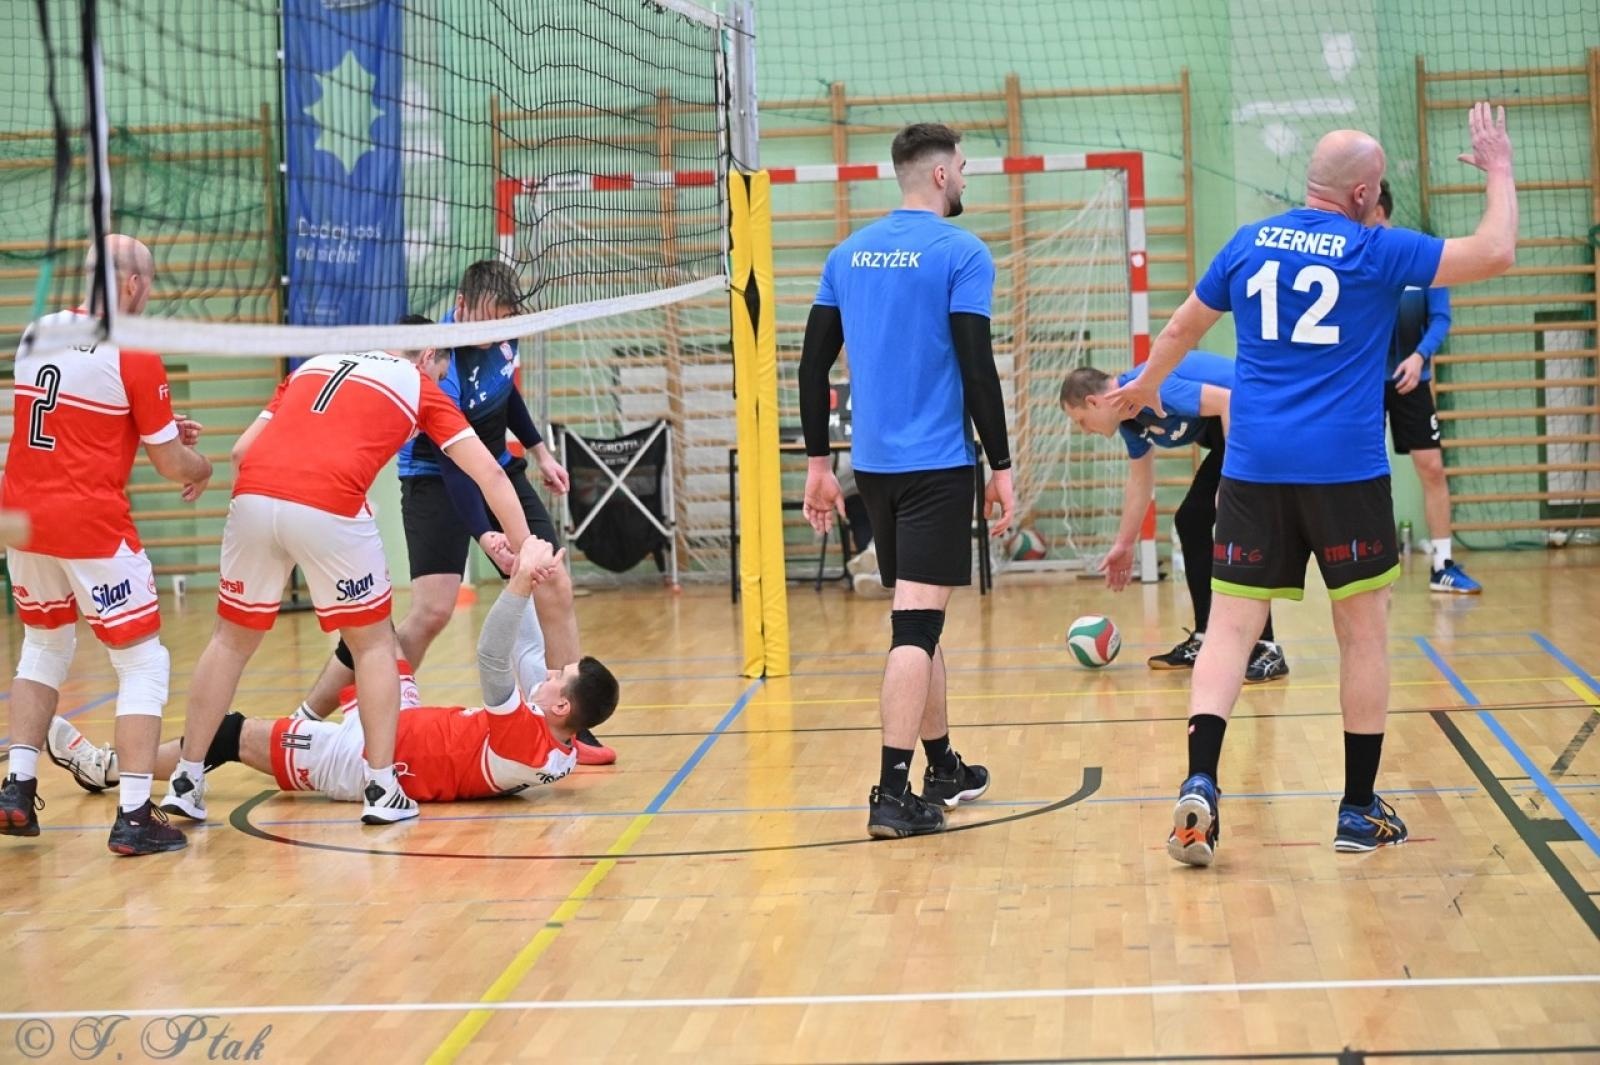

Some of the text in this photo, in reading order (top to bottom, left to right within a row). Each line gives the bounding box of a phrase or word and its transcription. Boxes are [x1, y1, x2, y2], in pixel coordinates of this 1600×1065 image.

[850, 248, 922, 268] KRZYŻEK
[1254, 226, 1347, 258] SZERNER
[1246, 259, 1340, 345] 12
[28, 363, 62, 451] 2
[91, 579, 132, 613] Silan
[219, 578, 245, 595] ersil
[335, 572, 375, 602] Silan
